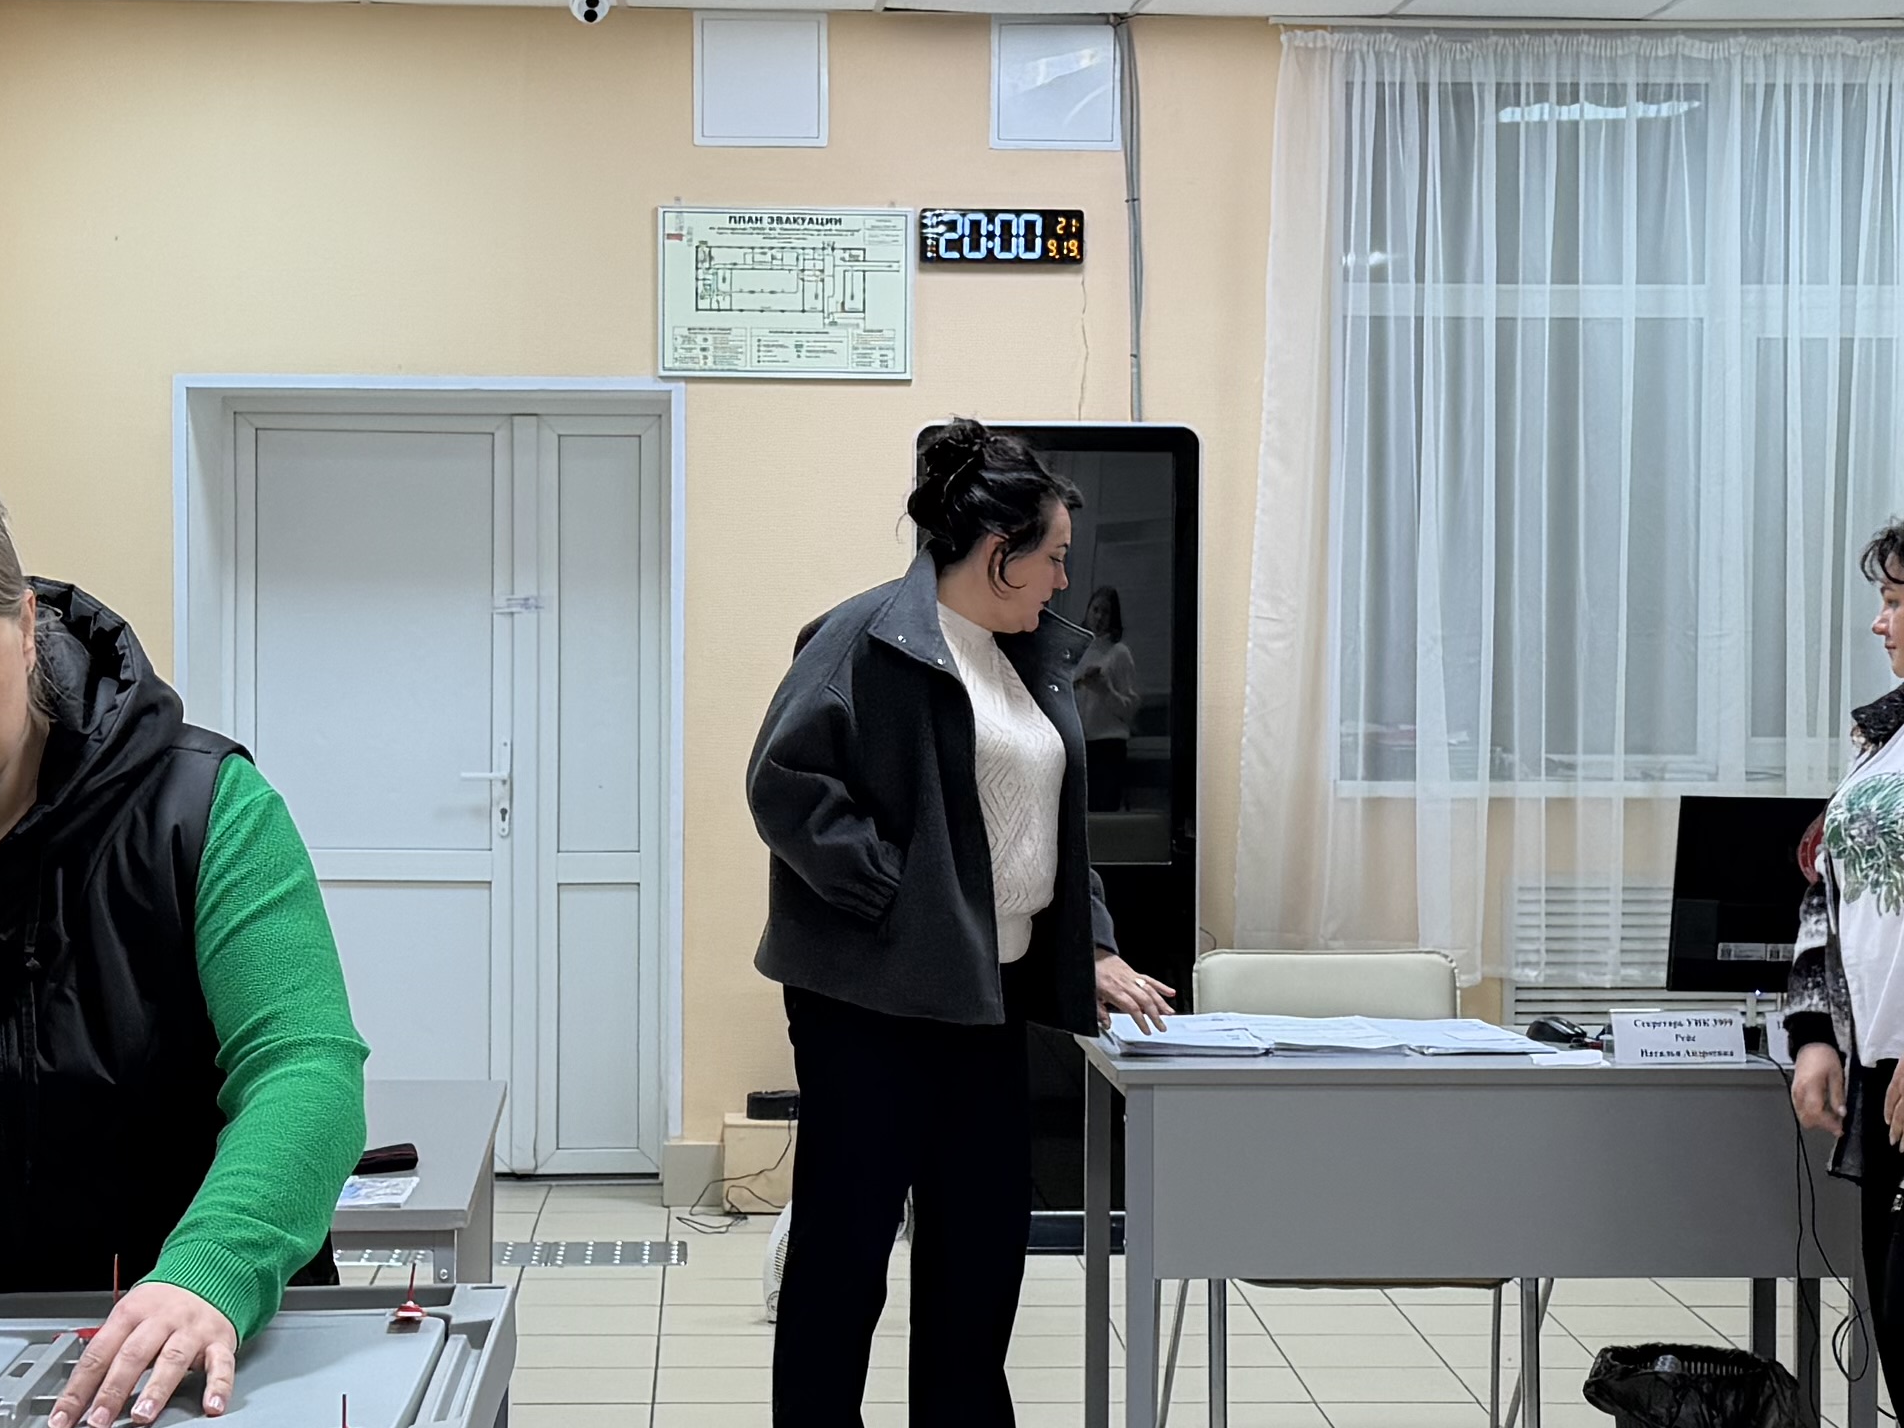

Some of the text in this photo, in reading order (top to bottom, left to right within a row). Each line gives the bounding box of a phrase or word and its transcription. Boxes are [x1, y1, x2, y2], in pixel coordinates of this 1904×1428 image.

[728, 215, 843, 227] ПЛАН ЭВАКУАЦИИ
[938, 213, 1043, 260] 20:00
